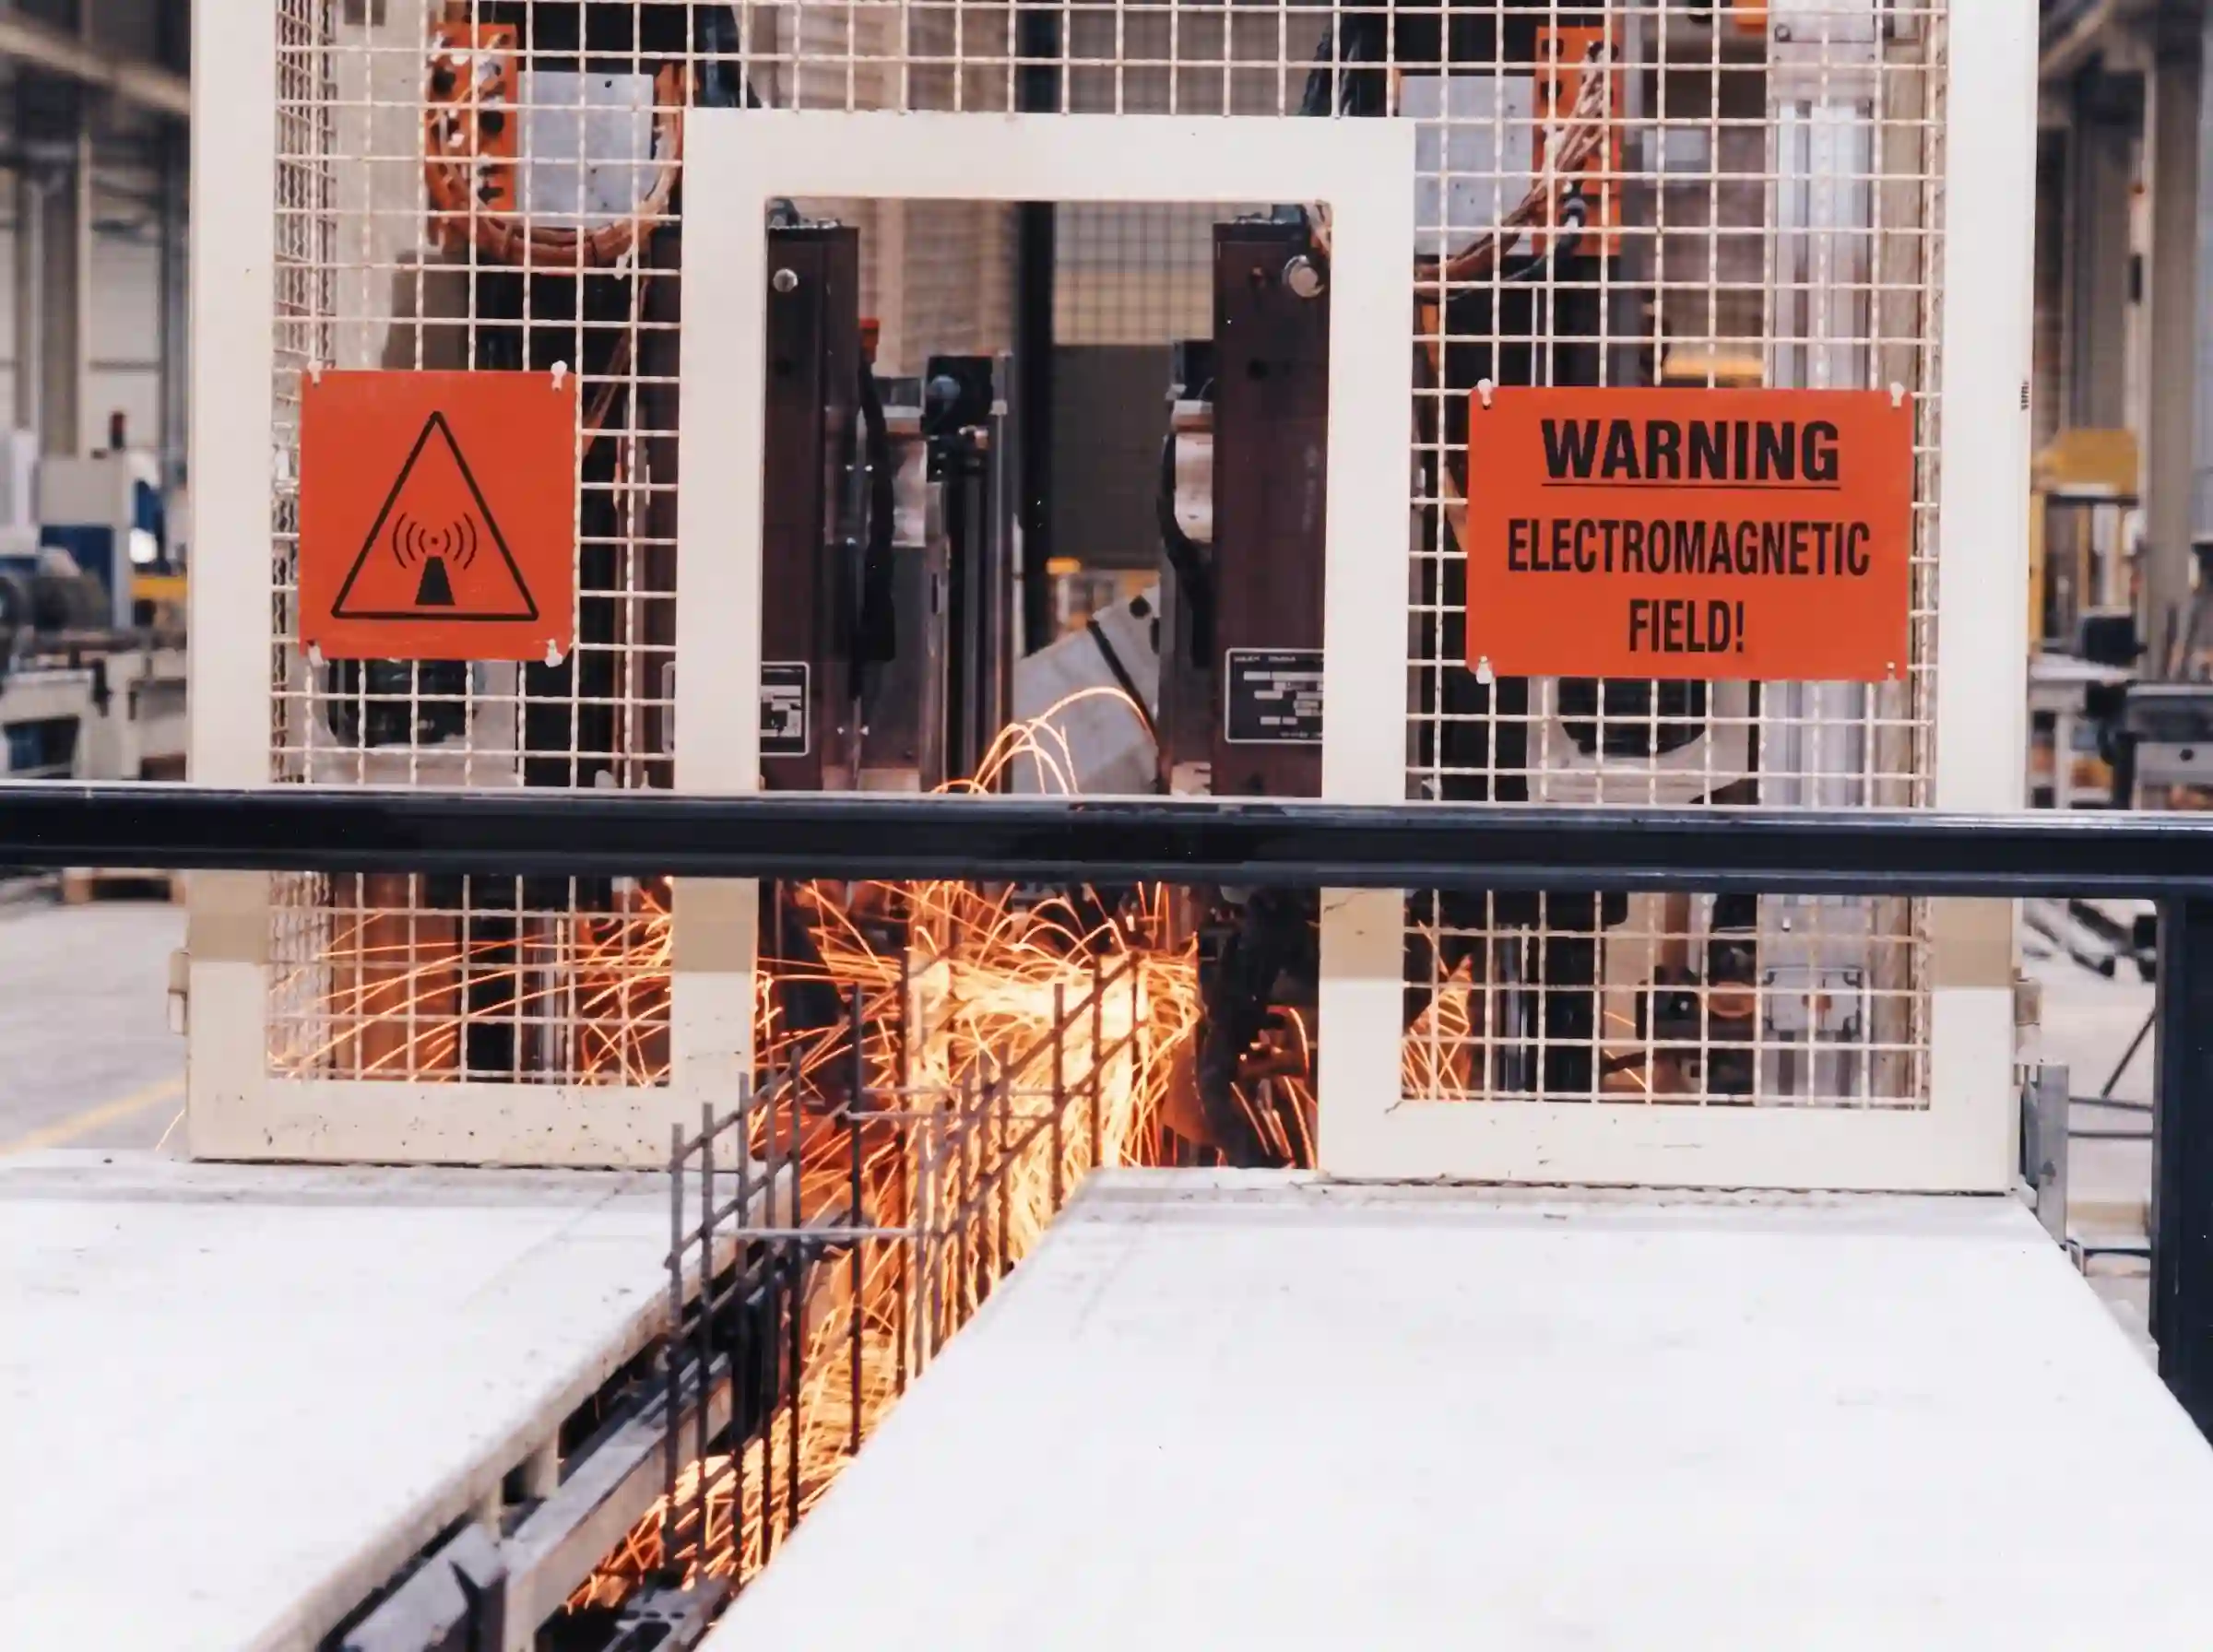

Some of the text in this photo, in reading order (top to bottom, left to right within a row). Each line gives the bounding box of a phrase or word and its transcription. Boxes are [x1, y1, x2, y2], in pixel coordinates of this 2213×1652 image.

[1541, 419, 1839, 480] WARNING
[1509, 519, 1871, 575] ELECTROMAGNETIC
[1628, 599, 1746, 653] FIELD!
